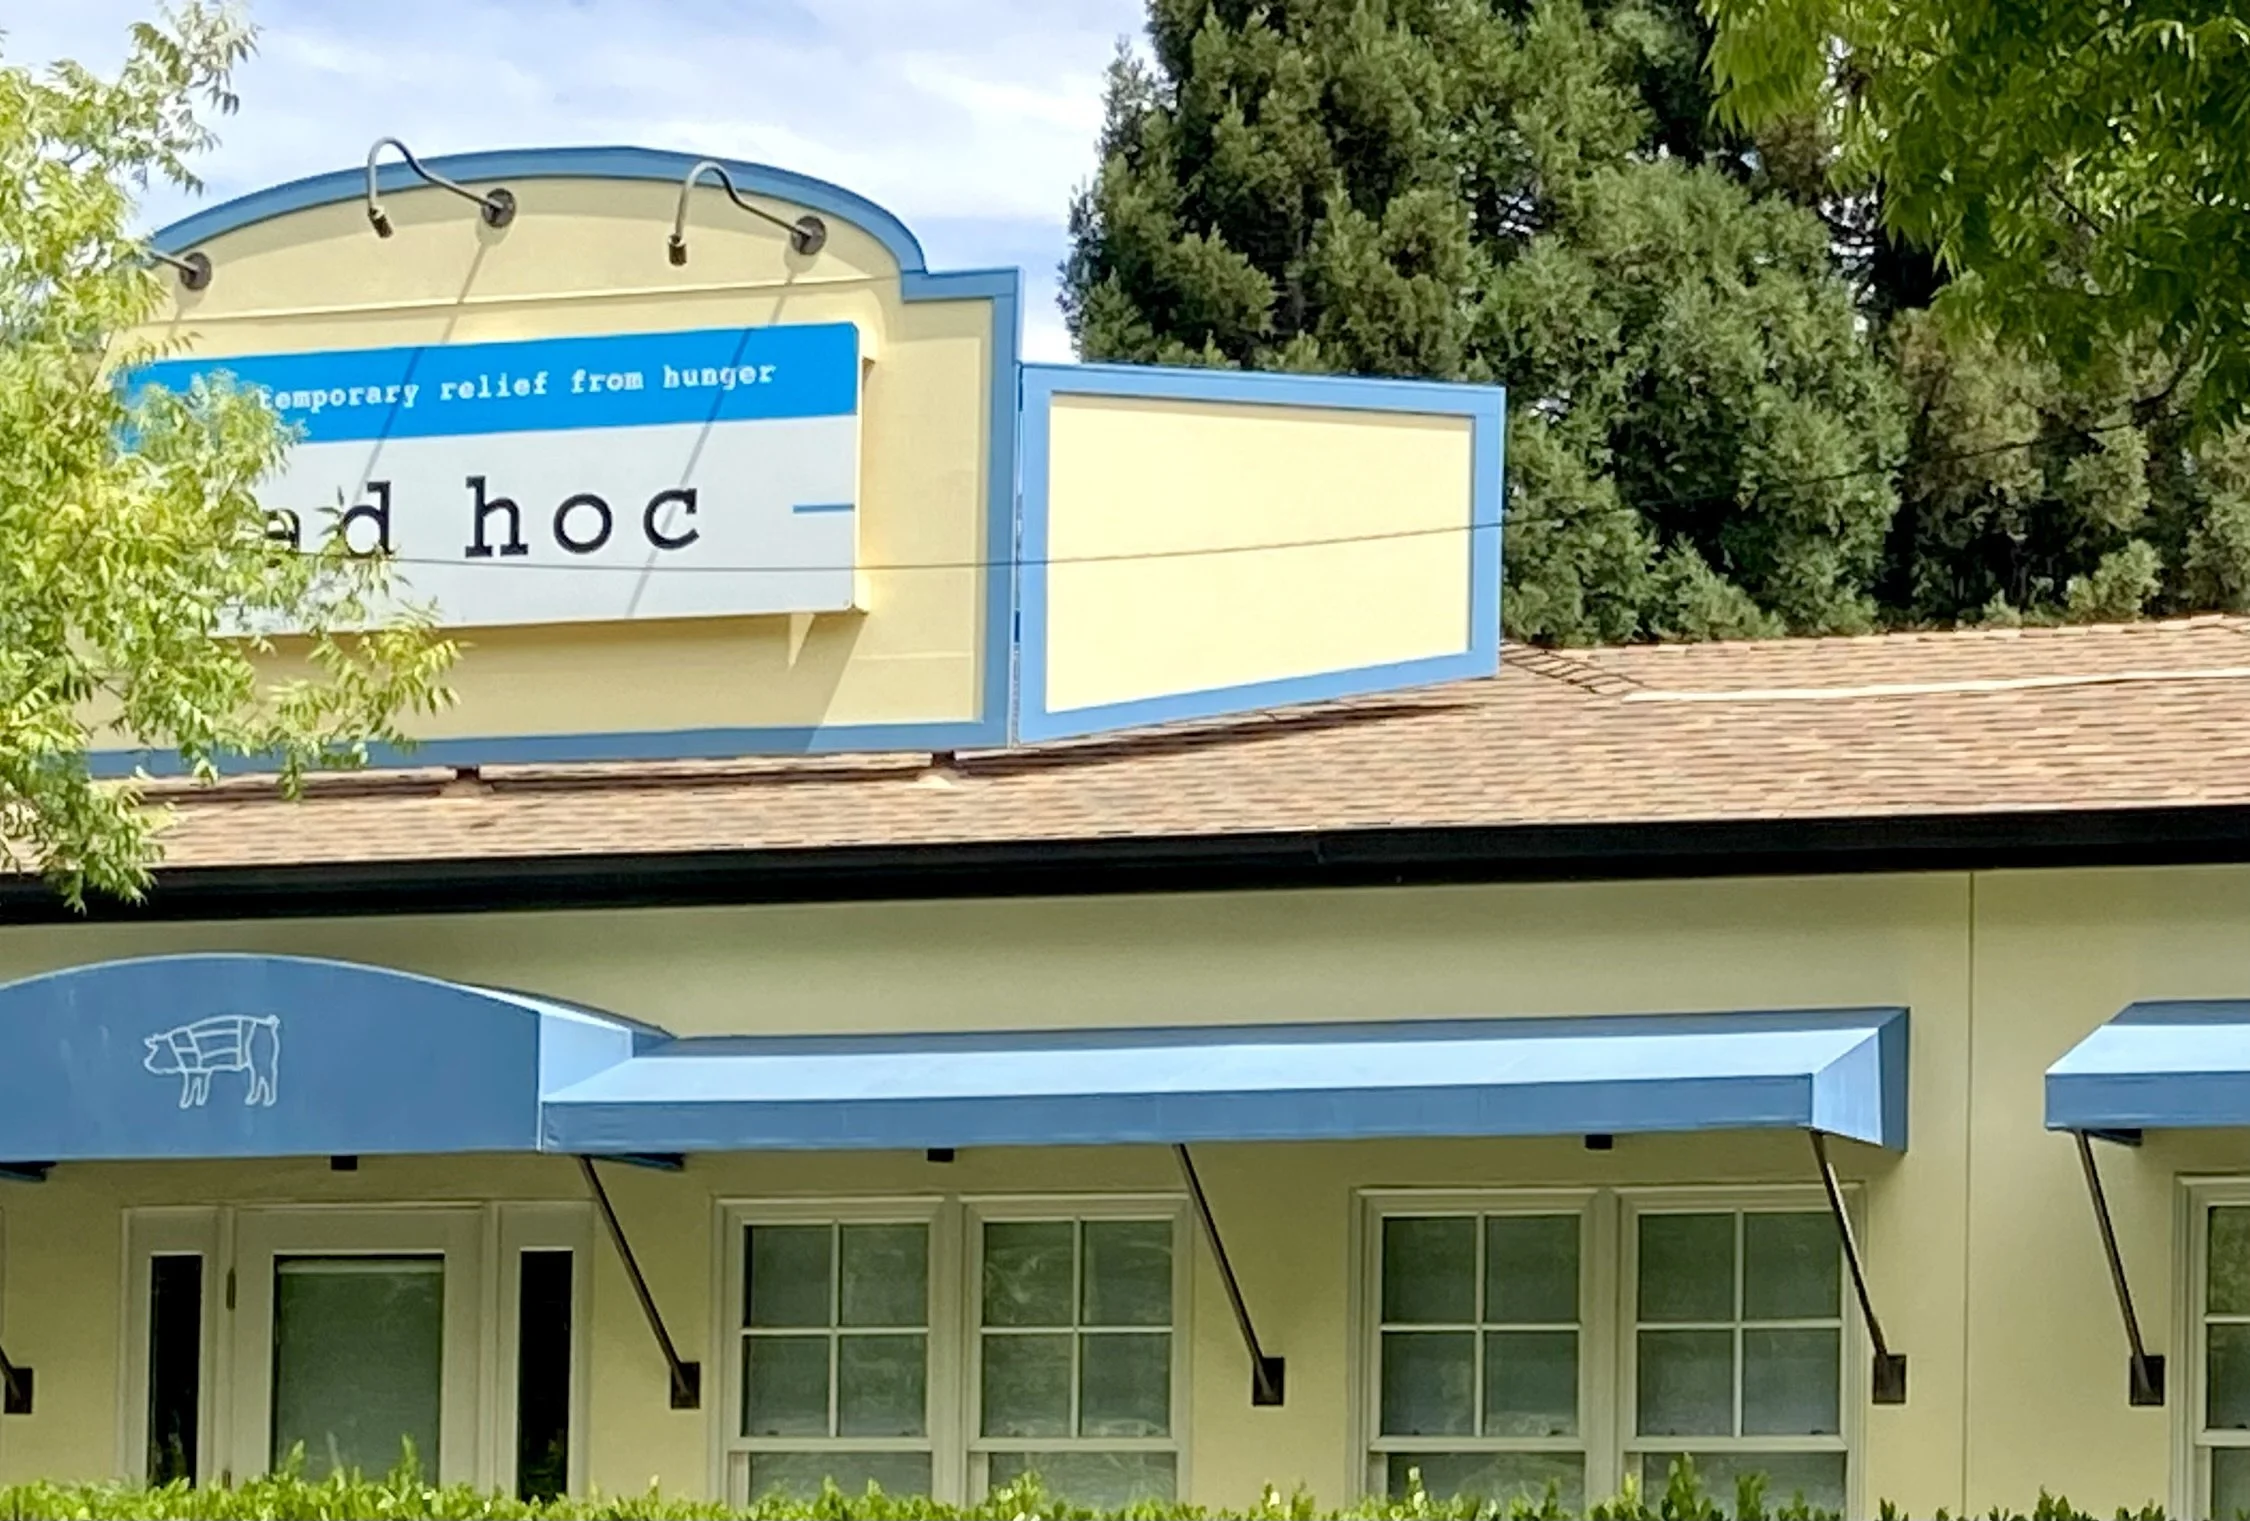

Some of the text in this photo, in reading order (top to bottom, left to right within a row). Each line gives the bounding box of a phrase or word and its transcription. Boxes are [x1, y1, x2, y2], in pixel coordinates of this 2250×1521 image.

[440, 372, 548, 399] relief
[571, 369, 643, 394] from
[664, 364, 776, 391] hunger
[465, 475, 699, 557] hoc
